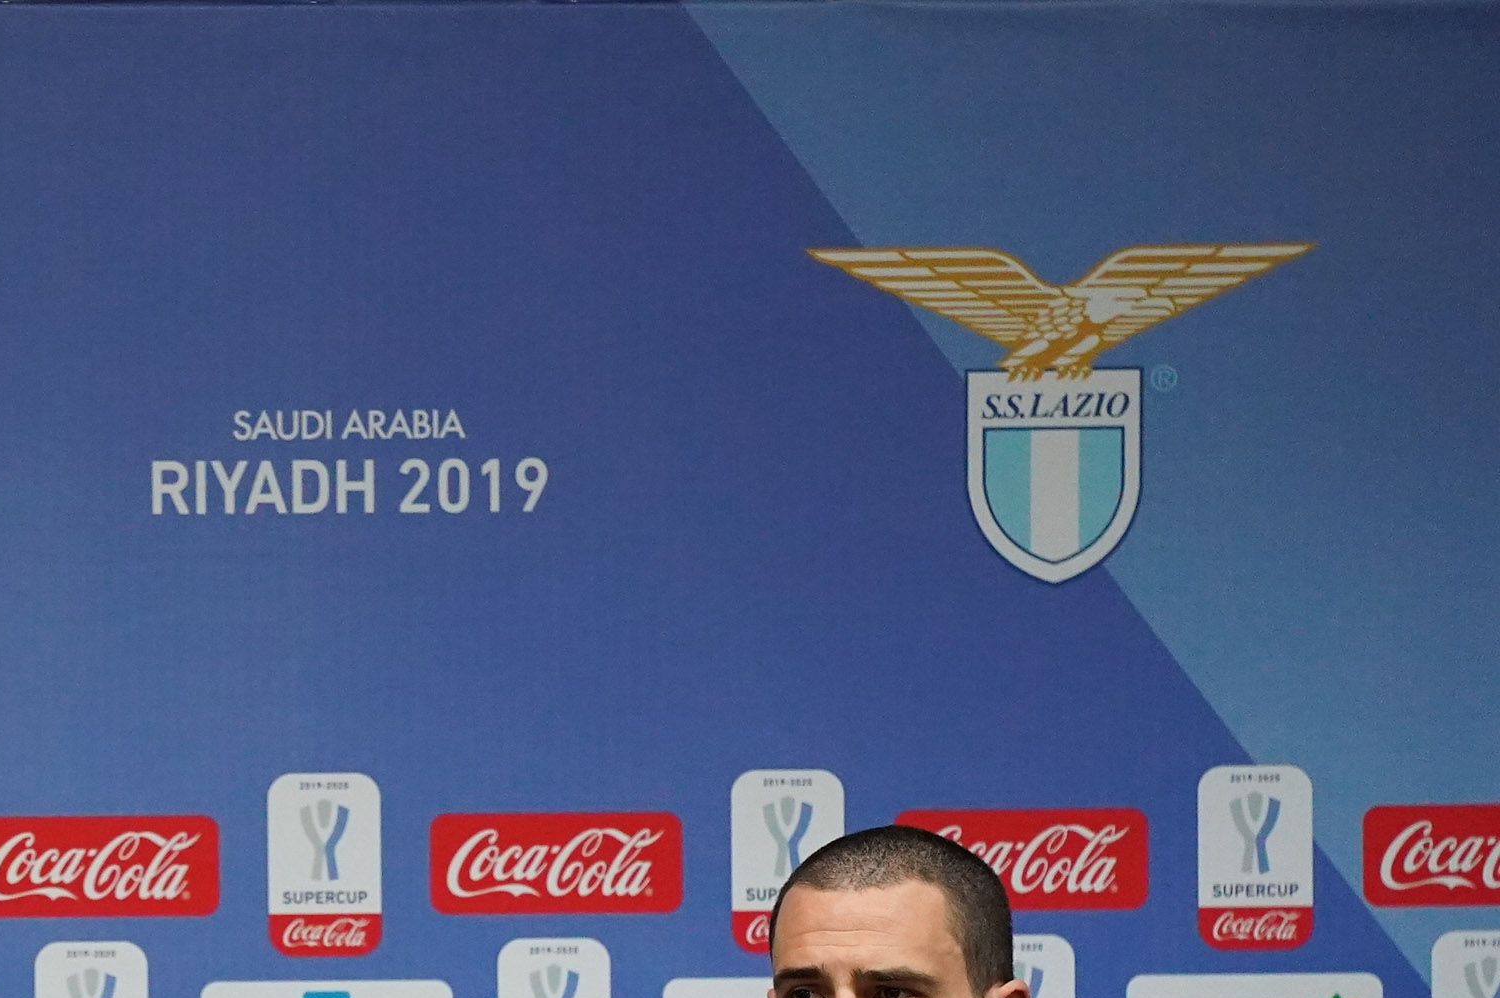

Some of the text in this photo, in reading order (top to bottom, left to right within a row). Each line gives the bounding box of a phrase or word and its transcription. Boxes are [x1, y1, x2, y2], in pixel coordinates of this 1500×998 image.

[232, 409, 465, 440] SAUDI ARABIA
[151, 458, 548, 515] RIYADH 2019
[446, 829, 662, 897] Coca-Cola
[282, 891, 367, 904] SUPERCUP
[1212, 884, 1298, 897] SUPERCUP
